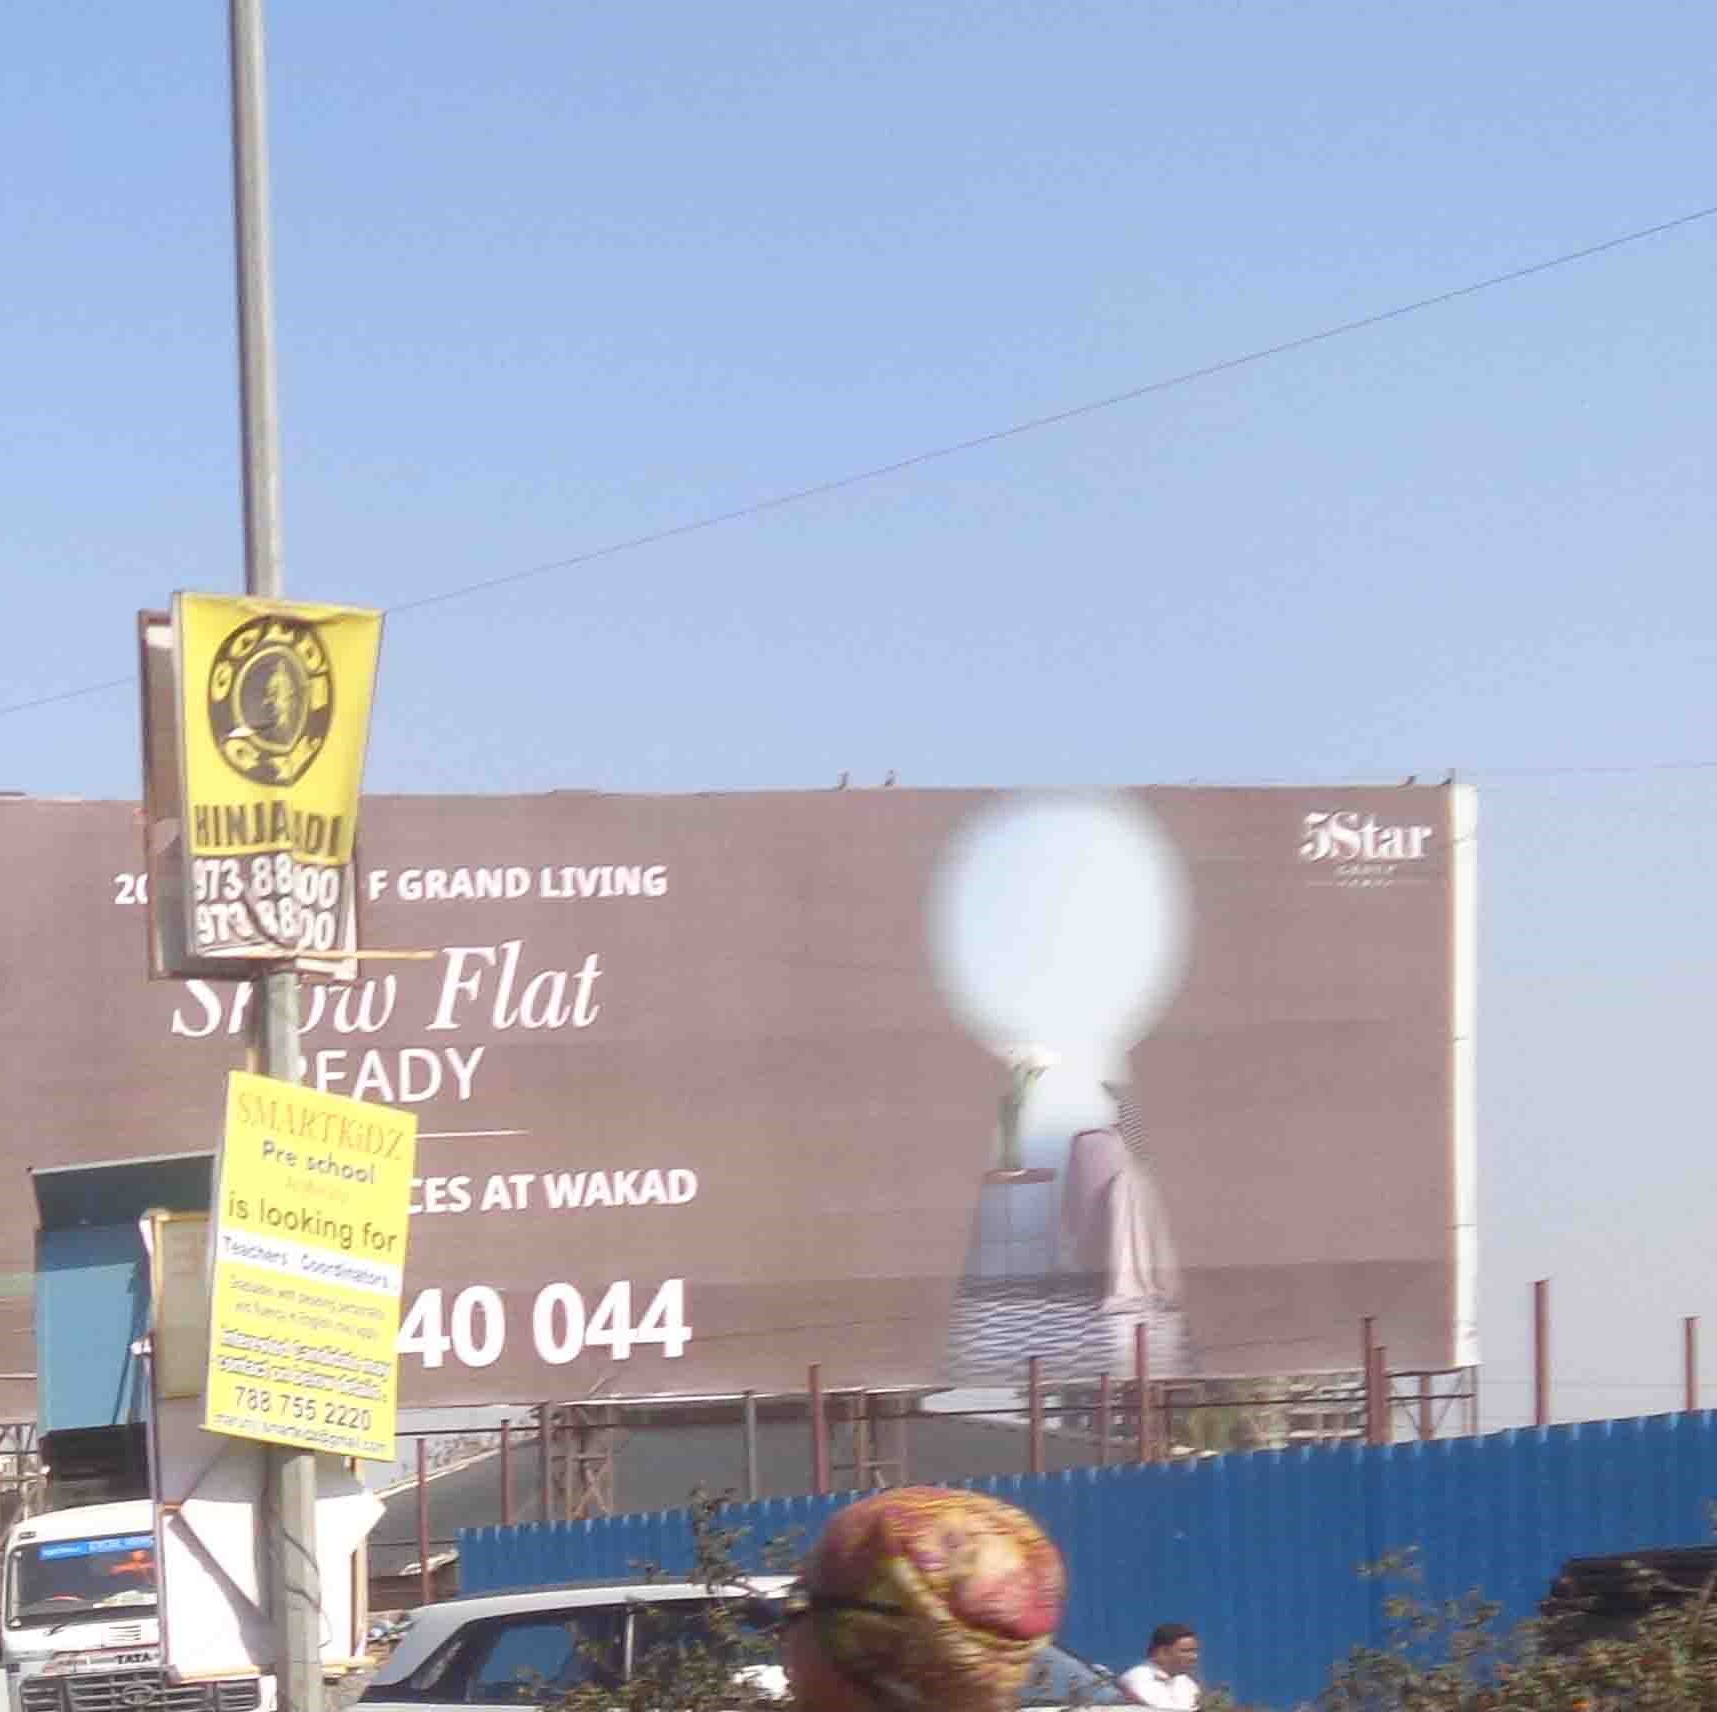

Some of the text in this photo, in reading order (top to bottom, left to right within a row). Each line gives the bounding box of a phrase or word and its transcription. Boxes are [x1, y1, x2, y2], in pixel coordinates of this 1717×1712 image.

[1301, 811, 1433, 861] 5Star
[397, 867, 531, 900] GRAND
[540, 864, 668, 898] LIVING
[426, 940, 602, 1032] Flat
[262, 1140, 376, 1185] Pre school
[408, 1169, 699, 1215] CES AT WAKAD
[228, 1190, 397, 1252] is looking for
[532, 1278, 693, 1366] 044
